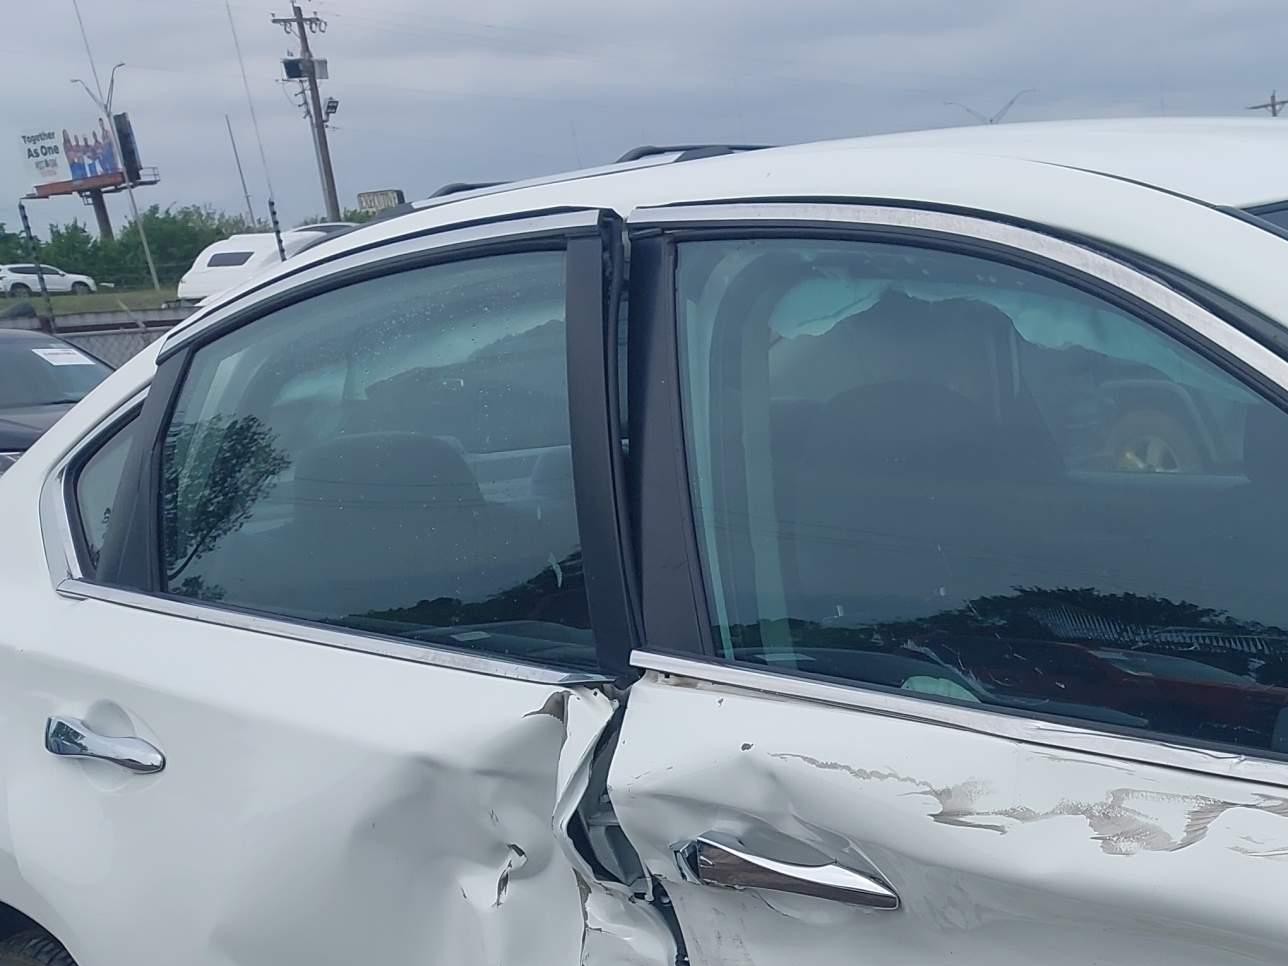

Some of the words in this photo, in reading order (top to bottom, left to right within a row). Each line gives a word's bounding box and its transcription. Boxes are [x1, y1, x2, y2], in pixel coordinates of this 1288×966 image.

[22, 132, 55, 144] Together
[27, 147, 40, 159] As
[41, 145, 59, 156] One
